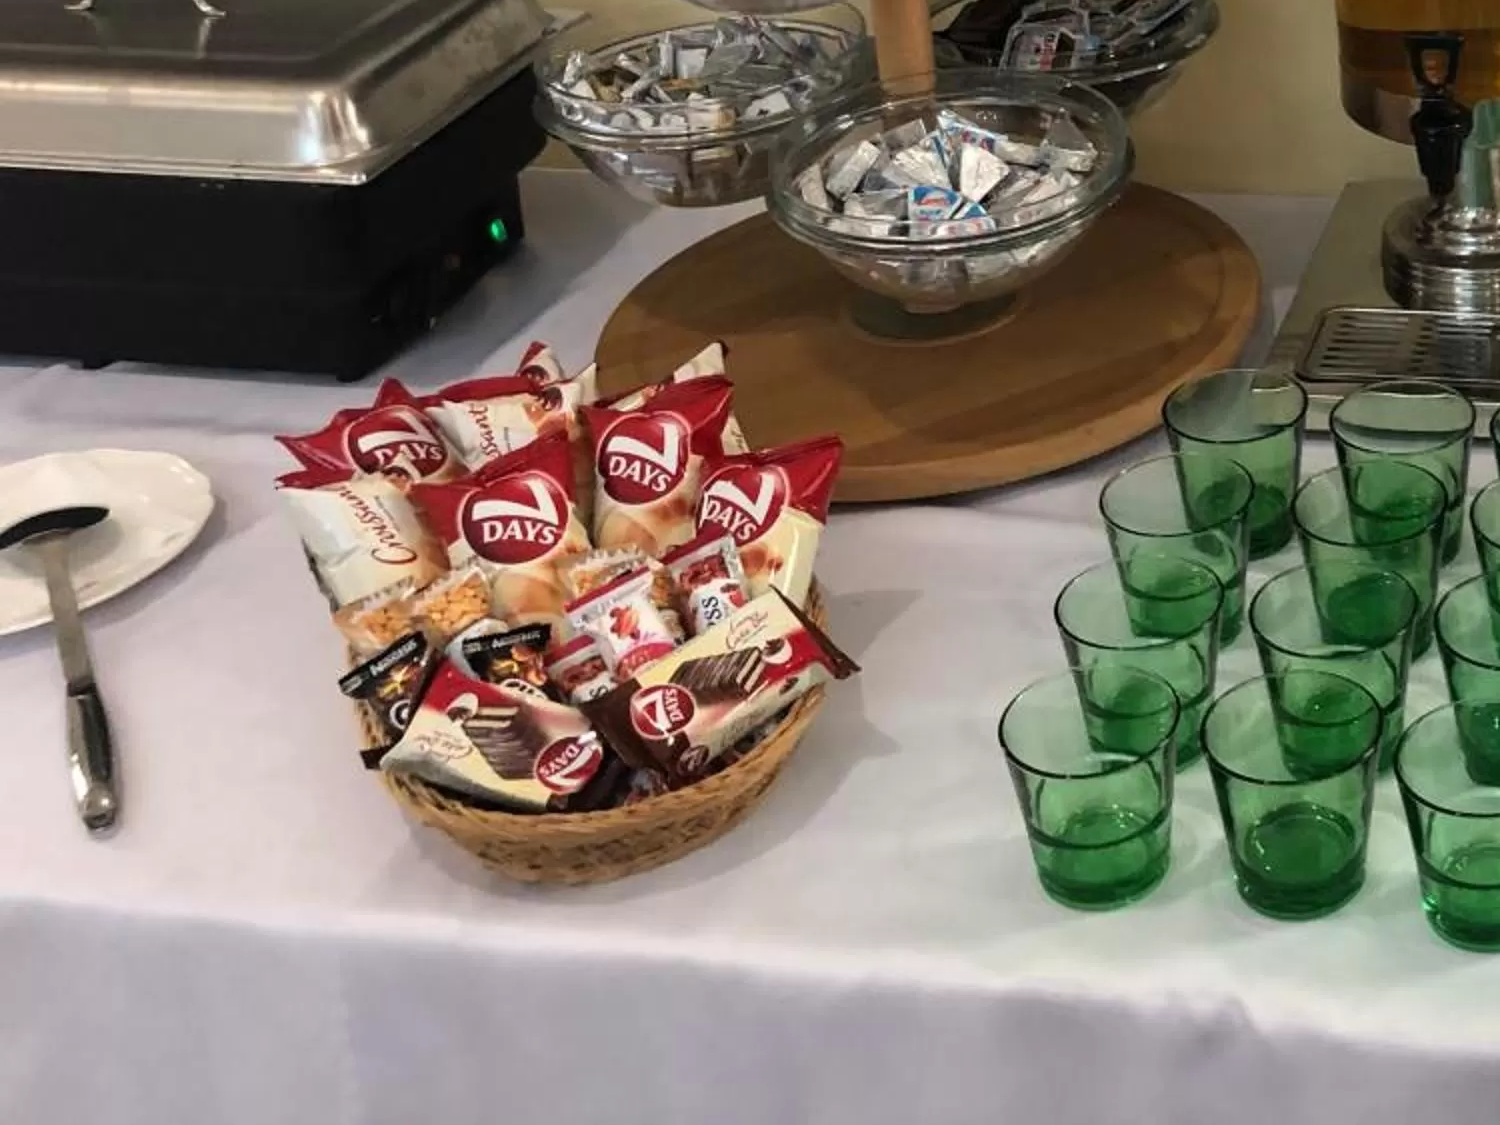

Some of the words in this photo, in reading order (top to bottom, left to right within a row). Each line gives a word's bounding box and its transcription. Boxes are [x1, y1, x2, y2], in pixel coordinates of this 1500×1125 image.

[605, 422, 680, 476] 7
[608, 455, 672, 493] DAYS
[471, 477, 559, 526] 7
[707, 470, 777, 526] 7
[481, 519, 559, 545] DAYS
[704, 499, 757, 541] DAYS
[663, 687, 685, 723] DAYS
[538, 742, 582, 777] DAYS
